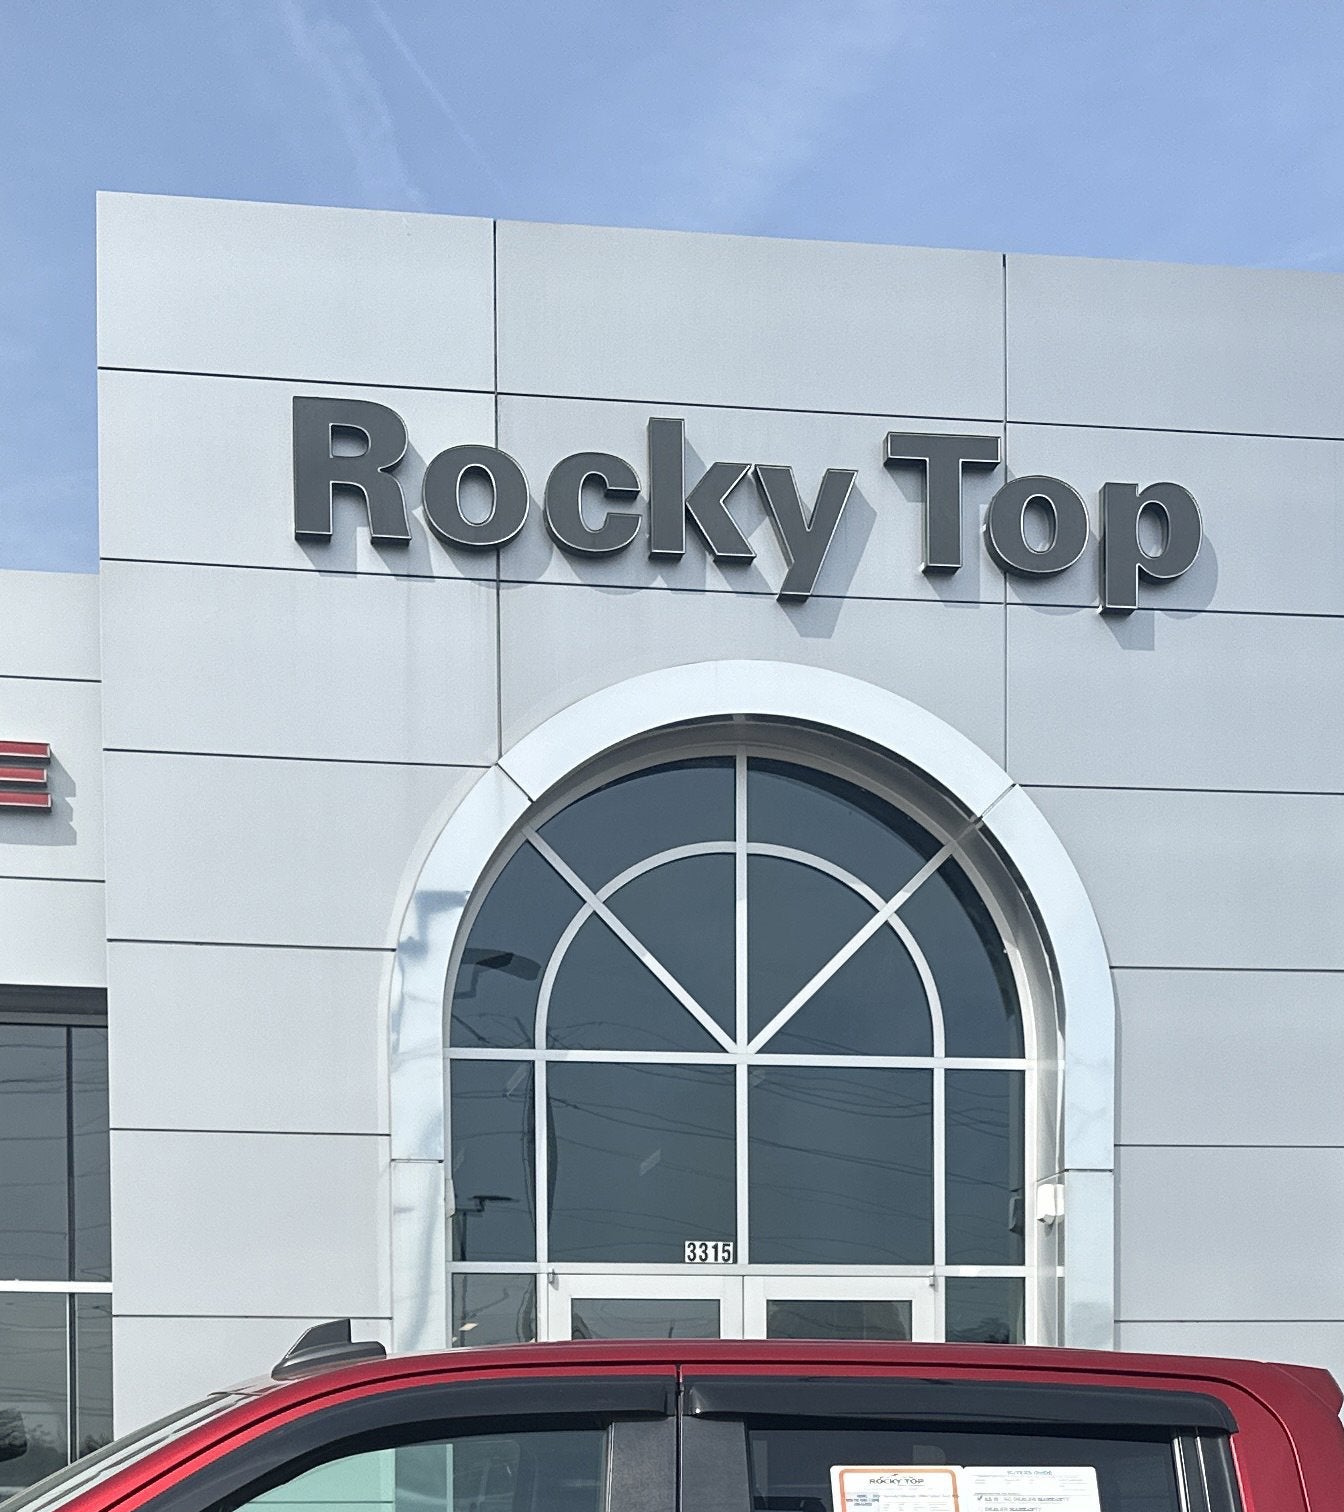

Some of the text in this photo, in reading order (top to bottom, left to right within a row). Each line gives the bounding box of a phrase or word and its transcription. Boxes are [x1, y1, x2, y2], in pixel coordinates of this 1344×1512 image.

[292, 395, 1204, 615] Rocky Top
[686, 1242, 732, 1263] 3315
